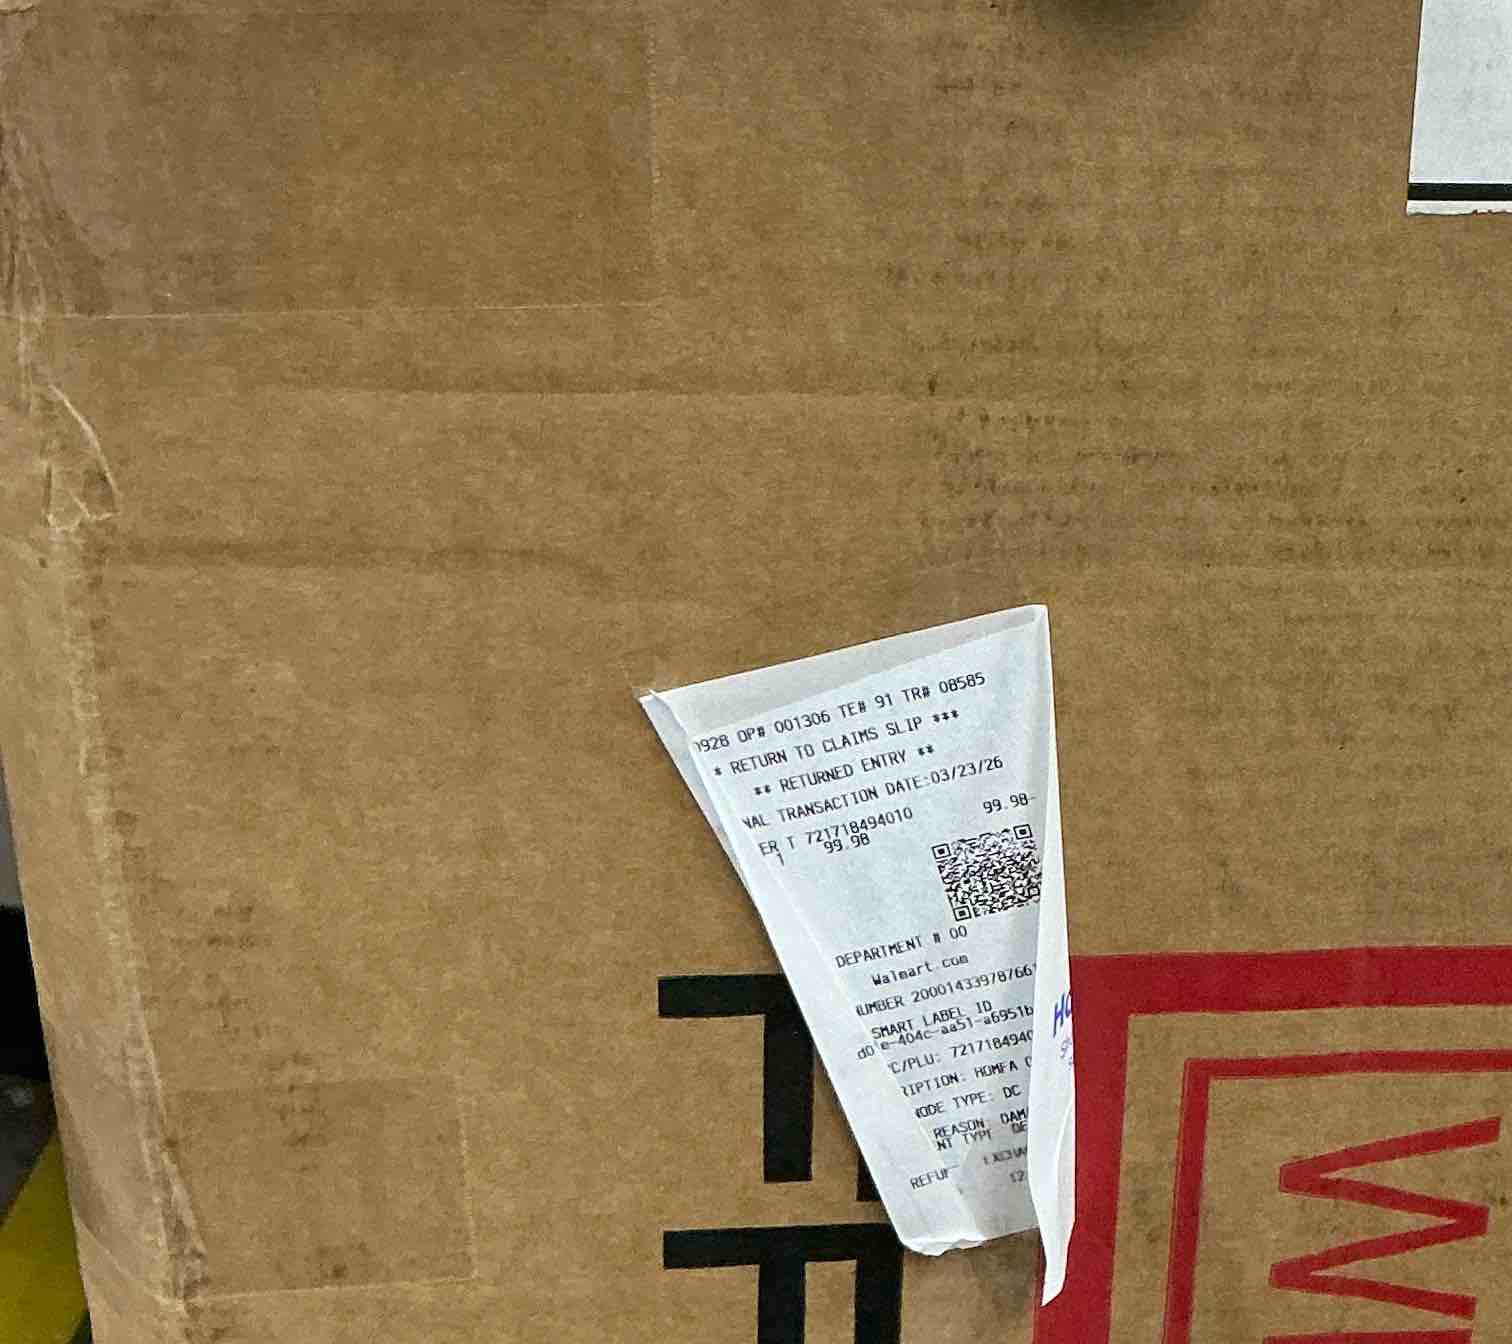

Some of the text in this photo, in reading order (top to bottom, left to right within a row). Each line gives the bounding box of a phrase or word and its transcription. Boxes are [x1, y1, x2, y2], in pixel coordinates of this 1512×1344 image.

[737, 726, 766, 744] OP#
[774, 710, 831, 734] 001306
[838, 700, 867, 719] TE#
[874, 693, 893, 709] 91
[901, 685, 931, 704] TR#
[938, 671, 986, 694] 08585
[730, 716, 923, 775] RETURN TO CLAIMS SLIP
[779, 749, 907, 792] RETURNED ENTRY
[777, 787, 880, 823] TRANSACTION
[786, 835, 796, 850] T
[805, 807, 913, 845] 721718494010
[823, 832, 871, 854] 99.98
[835, 924, 968, 969] DEPARTMENT # 00
[871, 999, 993, 1040] SMART LABEL ID
[888, 1053, 942, 1075] C/PLU:
[952, 1091, 995, 1109] TYPE:
[1002, 1084, 1023, 1099] DC
